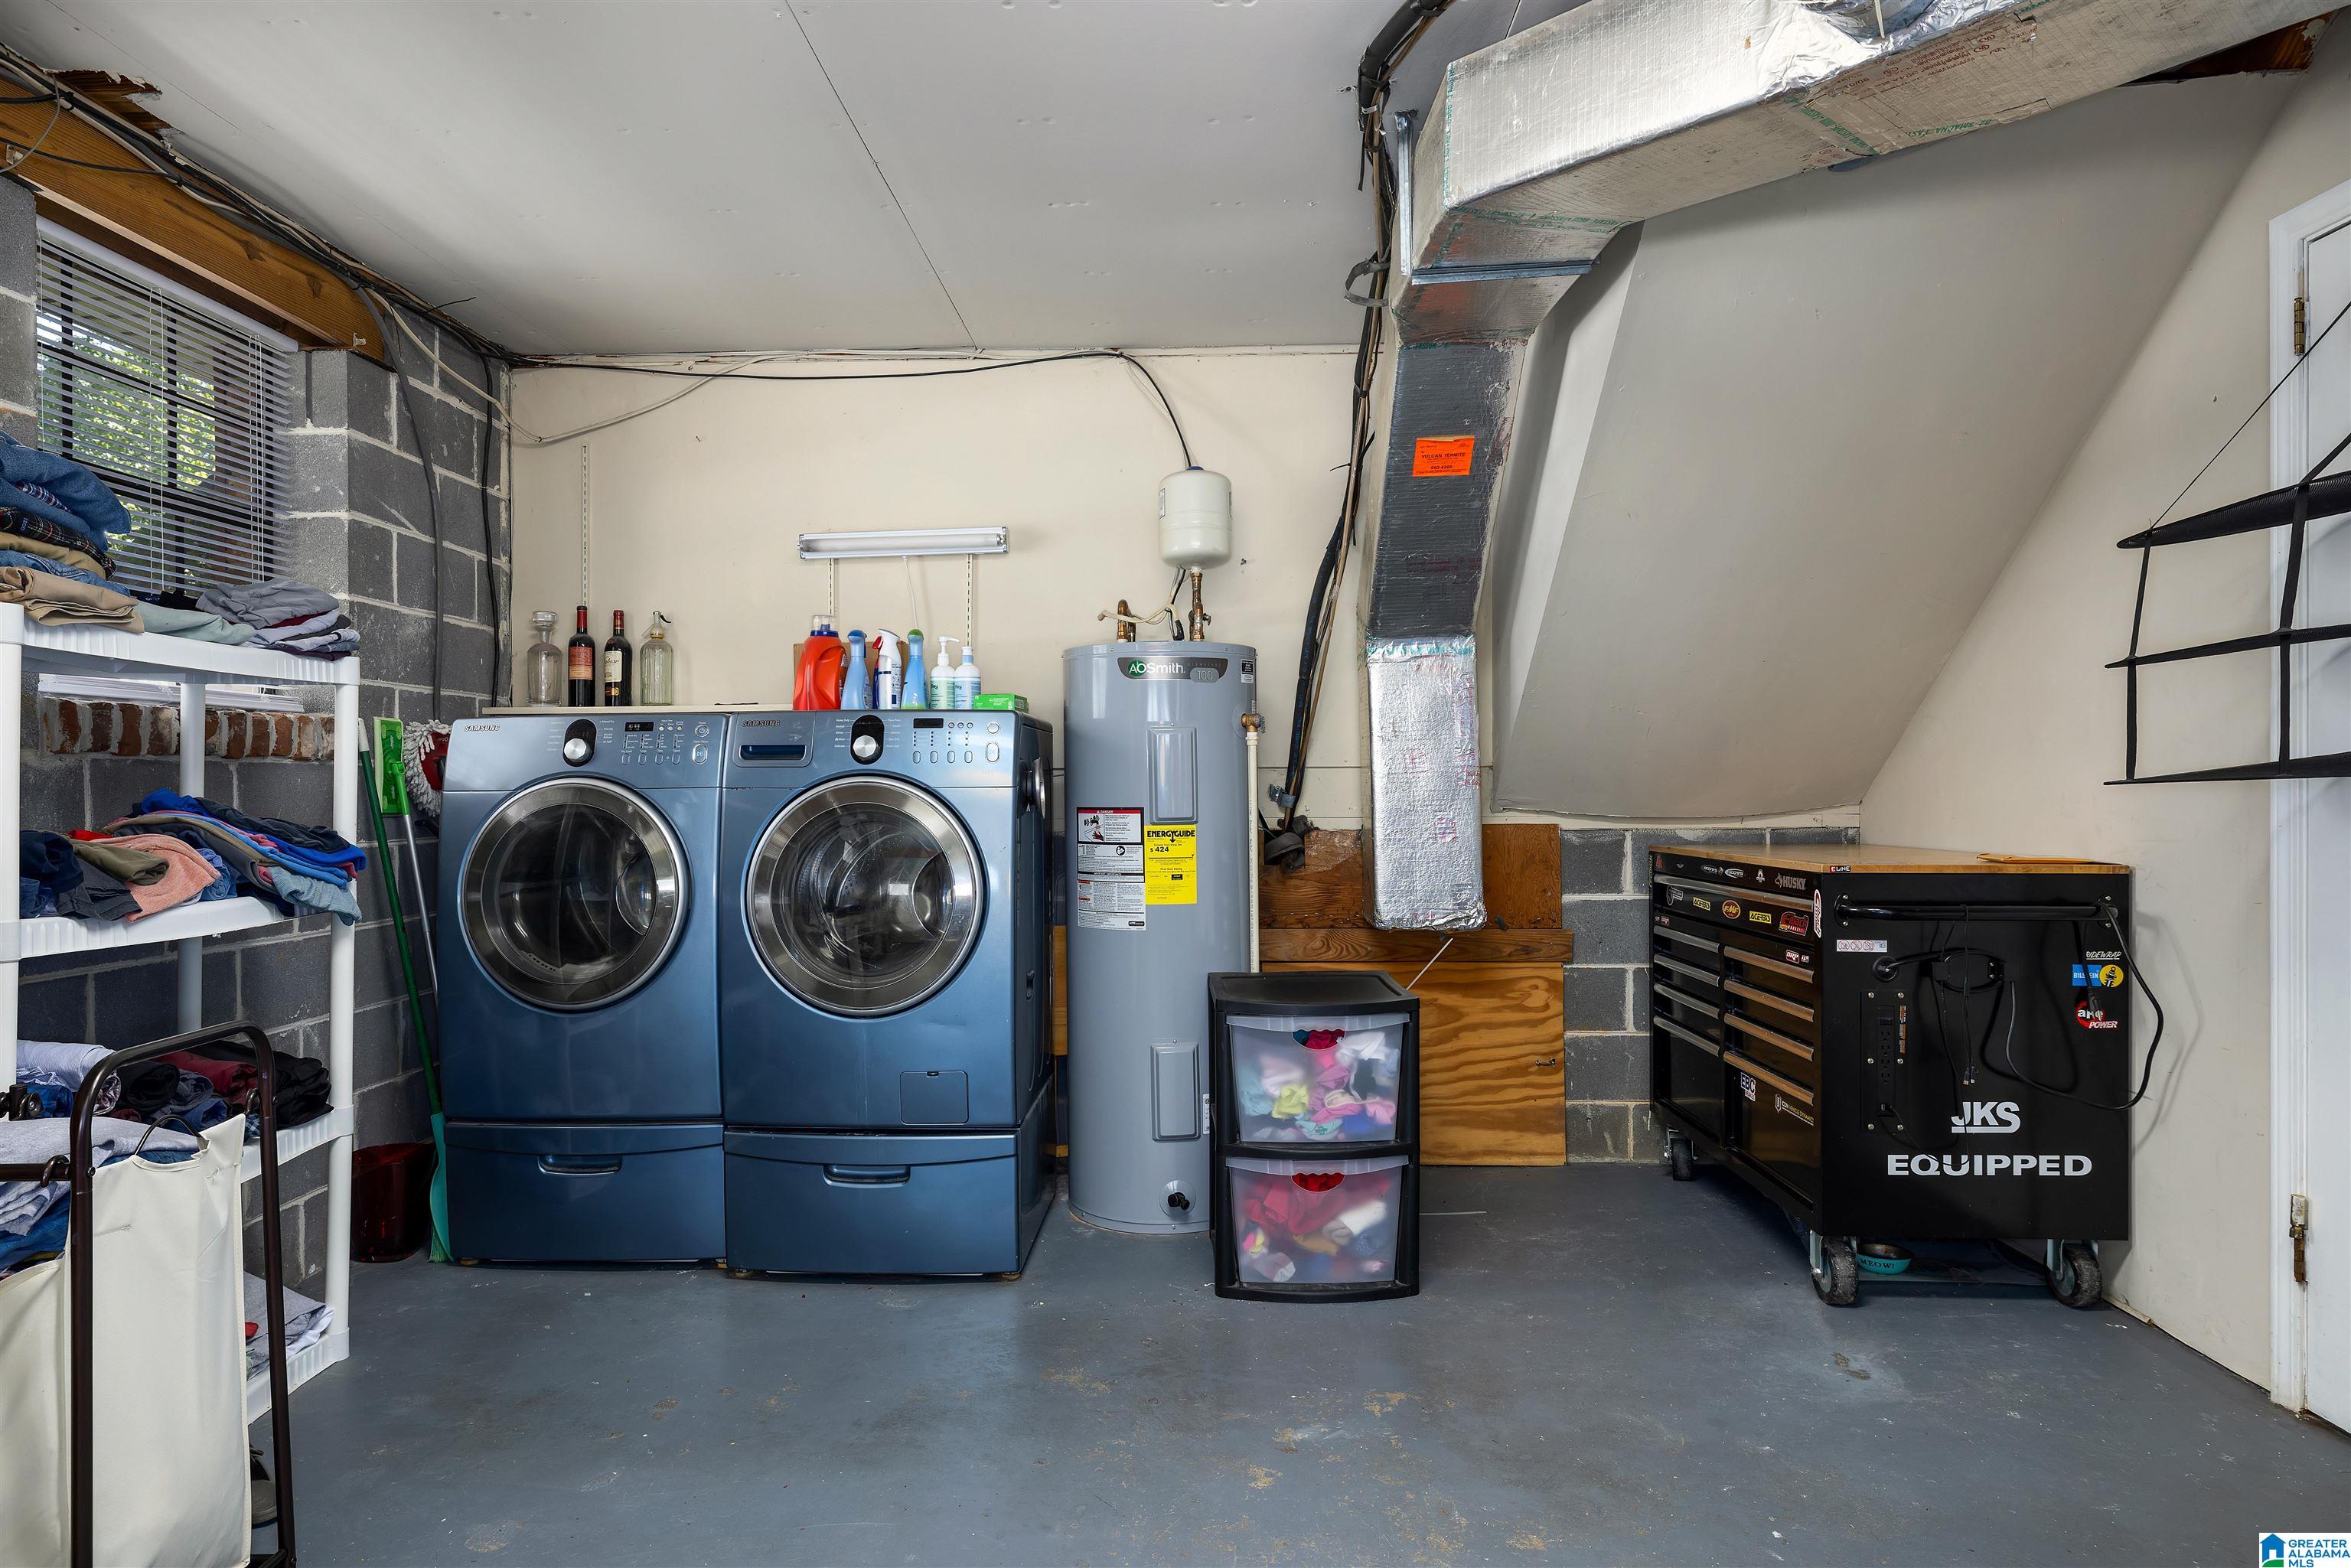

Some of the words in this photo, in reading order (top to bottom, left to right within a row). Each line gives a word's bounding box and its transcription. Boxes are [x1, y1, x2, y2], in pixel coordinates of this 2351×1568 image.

[1196, 670, 1213, 680] 100
[1782, 875, 1806, 890] HUSKY
[1750, 912, 1771, 922] ACERBIS
[2088, 1020, 2118, 1028] POWER
[1741, 1072, 1756, 1094] EBC
[1951, 1101, 2021, 1133] JKS
[1887, 1154, 2092, 1176] EQUIPPED
[1860, 1257, 1895, 1269] MEOW!
